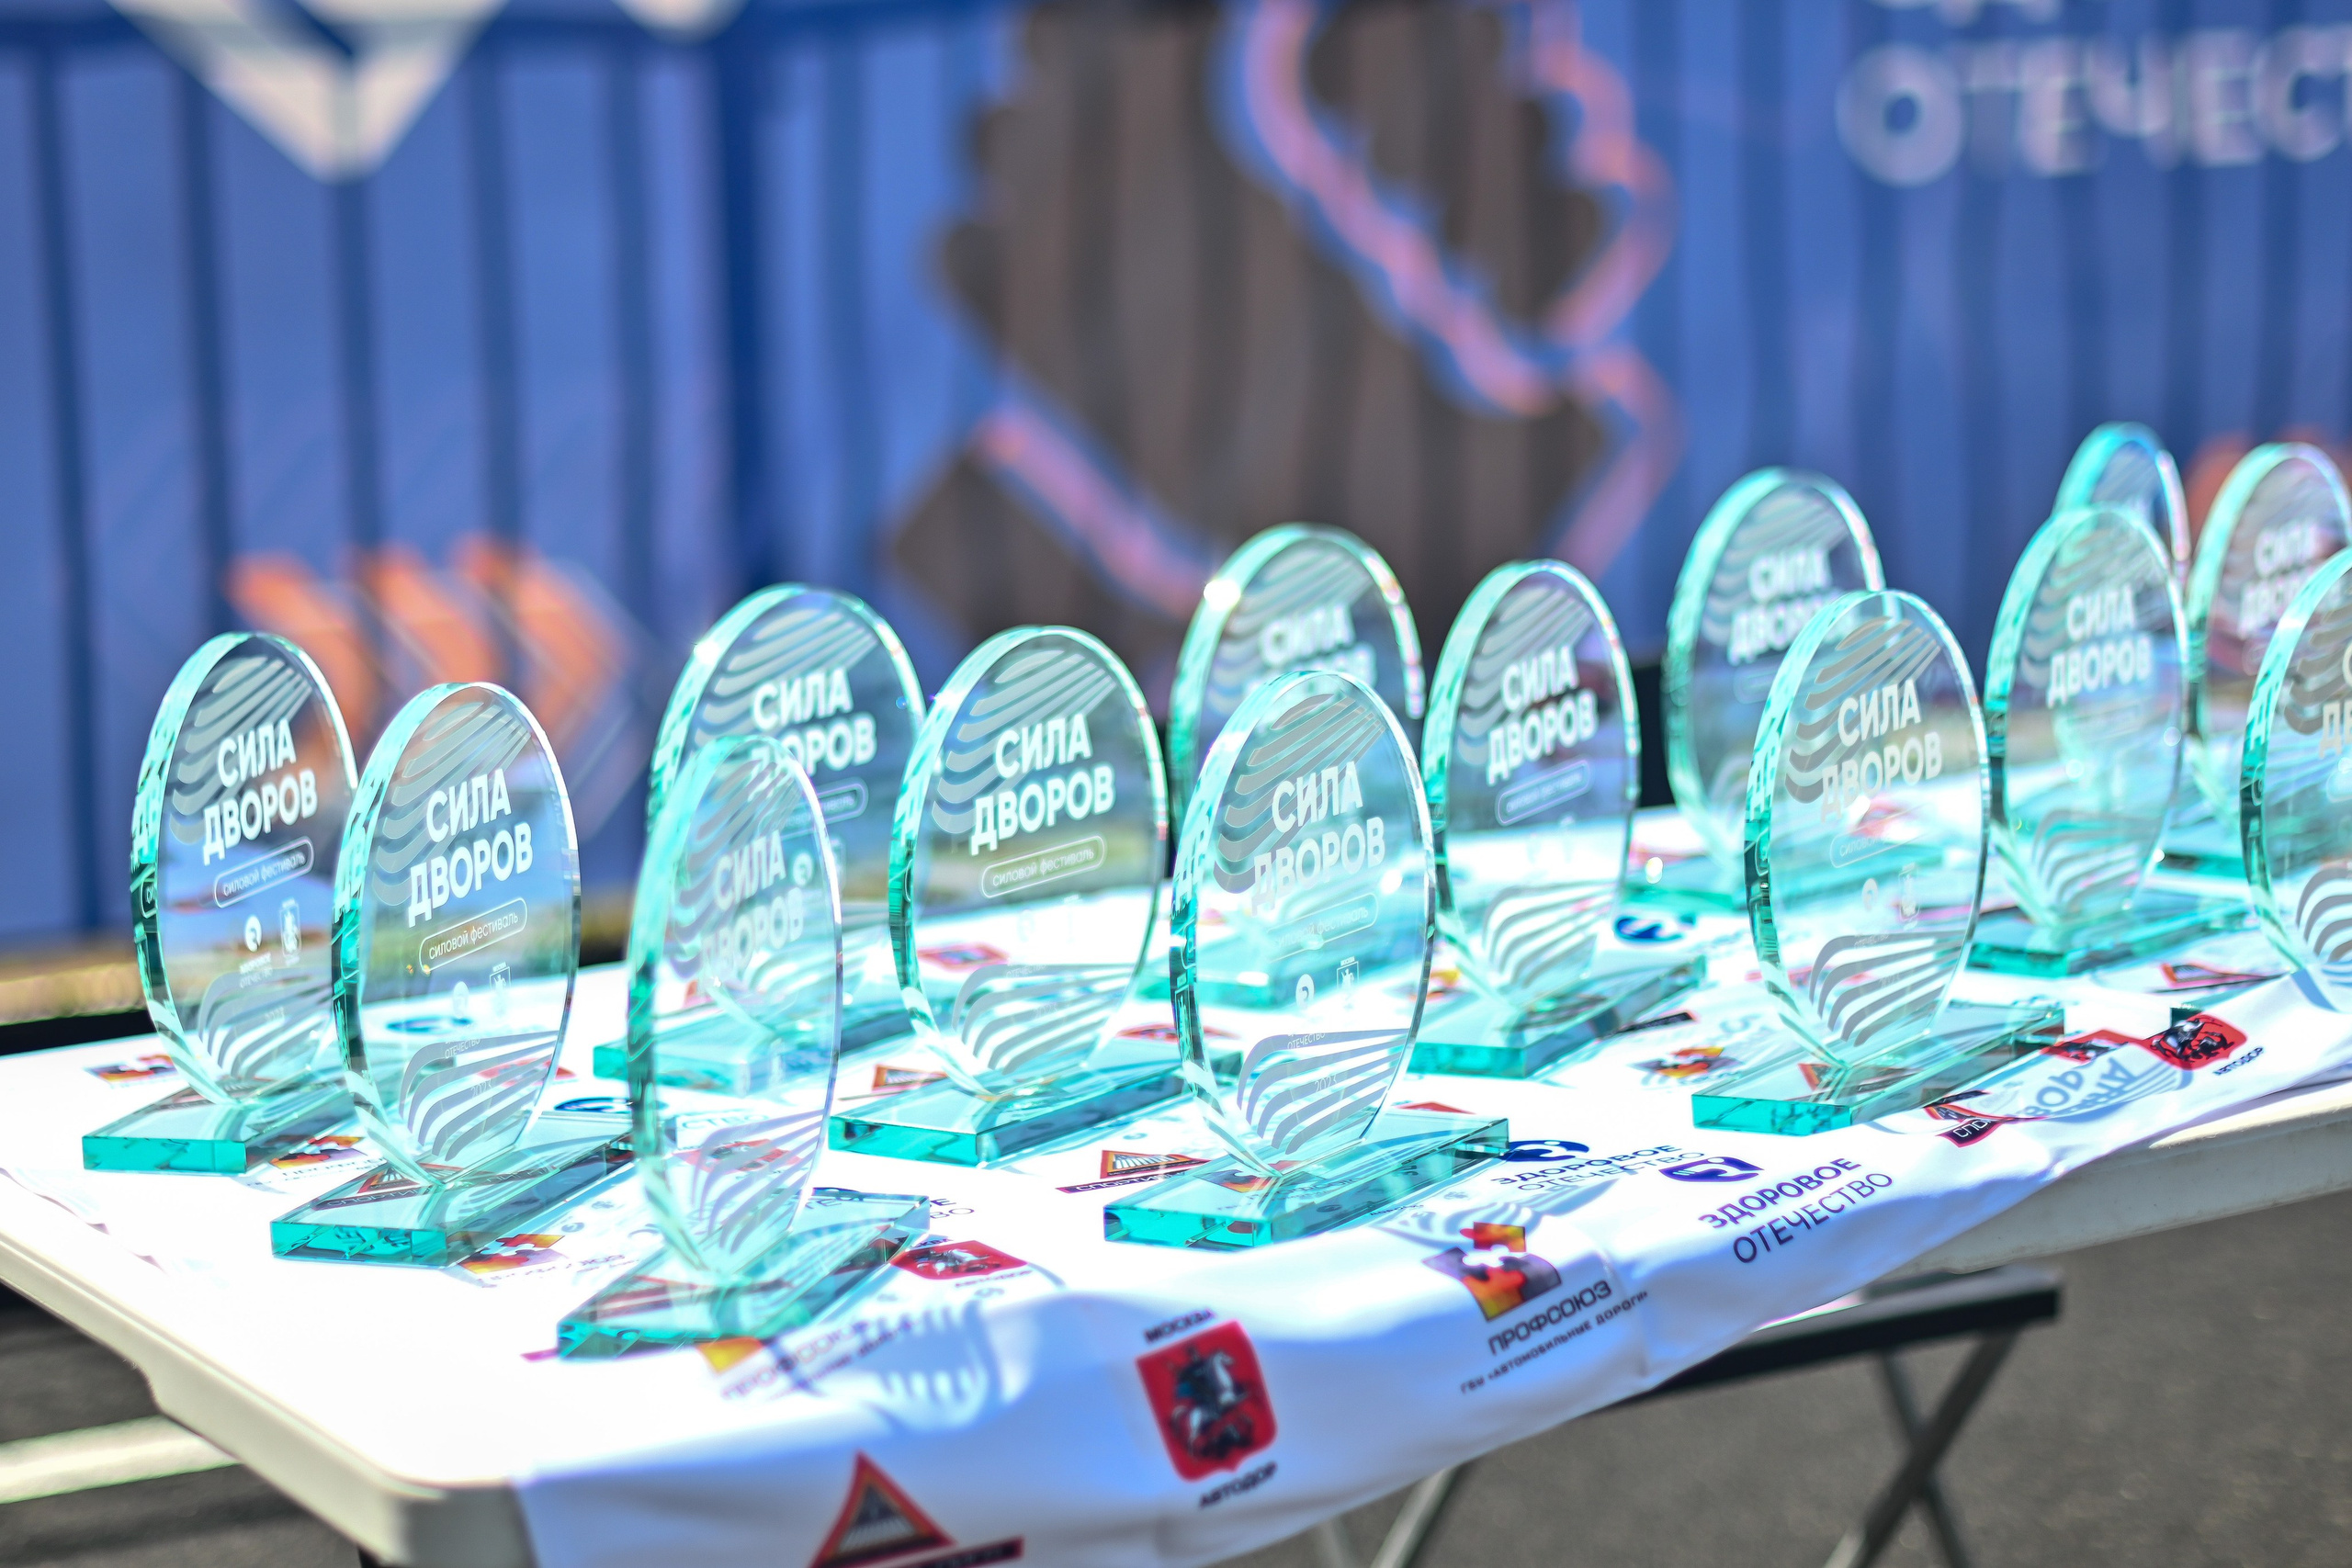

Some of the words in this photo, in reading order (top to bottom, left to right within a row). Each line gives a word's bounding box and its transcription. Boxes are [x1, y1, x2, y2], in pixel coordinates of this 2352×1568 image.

[1748, 547, 1832, 604] СИЛА
[1260, 603, 1356, 666] СИЛА
[2066, 584, 2137, 640] СИЛА
[752, 667, 854, 732] СИЛА
[1501, 645, 1578, 712] СИЛА
[2047, 634, 2153, 709] ДВОРОВ
[995, 713, 1091, 780] СИЛА
[1487, 689, 1598, 785] ДВОРОВ
[1838, 679, 1922, 747] СИЛА
[218, 719, 296, 788] СИЛА
[1821, 731, 1942, 823] ДВОРОВ
[203, 769, 318, 866] ДВОРОВ
[425, 768, 512, 843] СИЛА
[970, 765, 1115, 855] ДВОРОВ
[1272, 761, 1363, 833] СИЛА
[408, 822, 533, 928] ДВОРОВ
[713, 829, 786, 912] СИЛА
[992, 862, 1037, 887] силовой
[1040, 846, 1094, 877] фестиваль
[1251, 816, 1385, 916] ДВОРОВ
[428, 931, 469, 961] силовой
[470, 912, 519, 946] фестиваль
[698, 887, 805, 994] ДВОРОВ
[444, 1038, 481, 1060] ОТЕЧЕСТВО
[1286, 1032, 1326, 1051] ОТЕЧЕСТВО
[1490, 1145, 1681, 1185] ЗДОРОВОЕ
[1518, 1151, 1705, 1190] ОТЕЧЕСТВО
[1698, 1157, 1861, 1229] ЗДОРОВОЕ
[1733, 1173, 1893, 1264] ОТЕЧЕСТВО
[1487, 1280, 1612, 1356] ПРОФСОЮЗ
